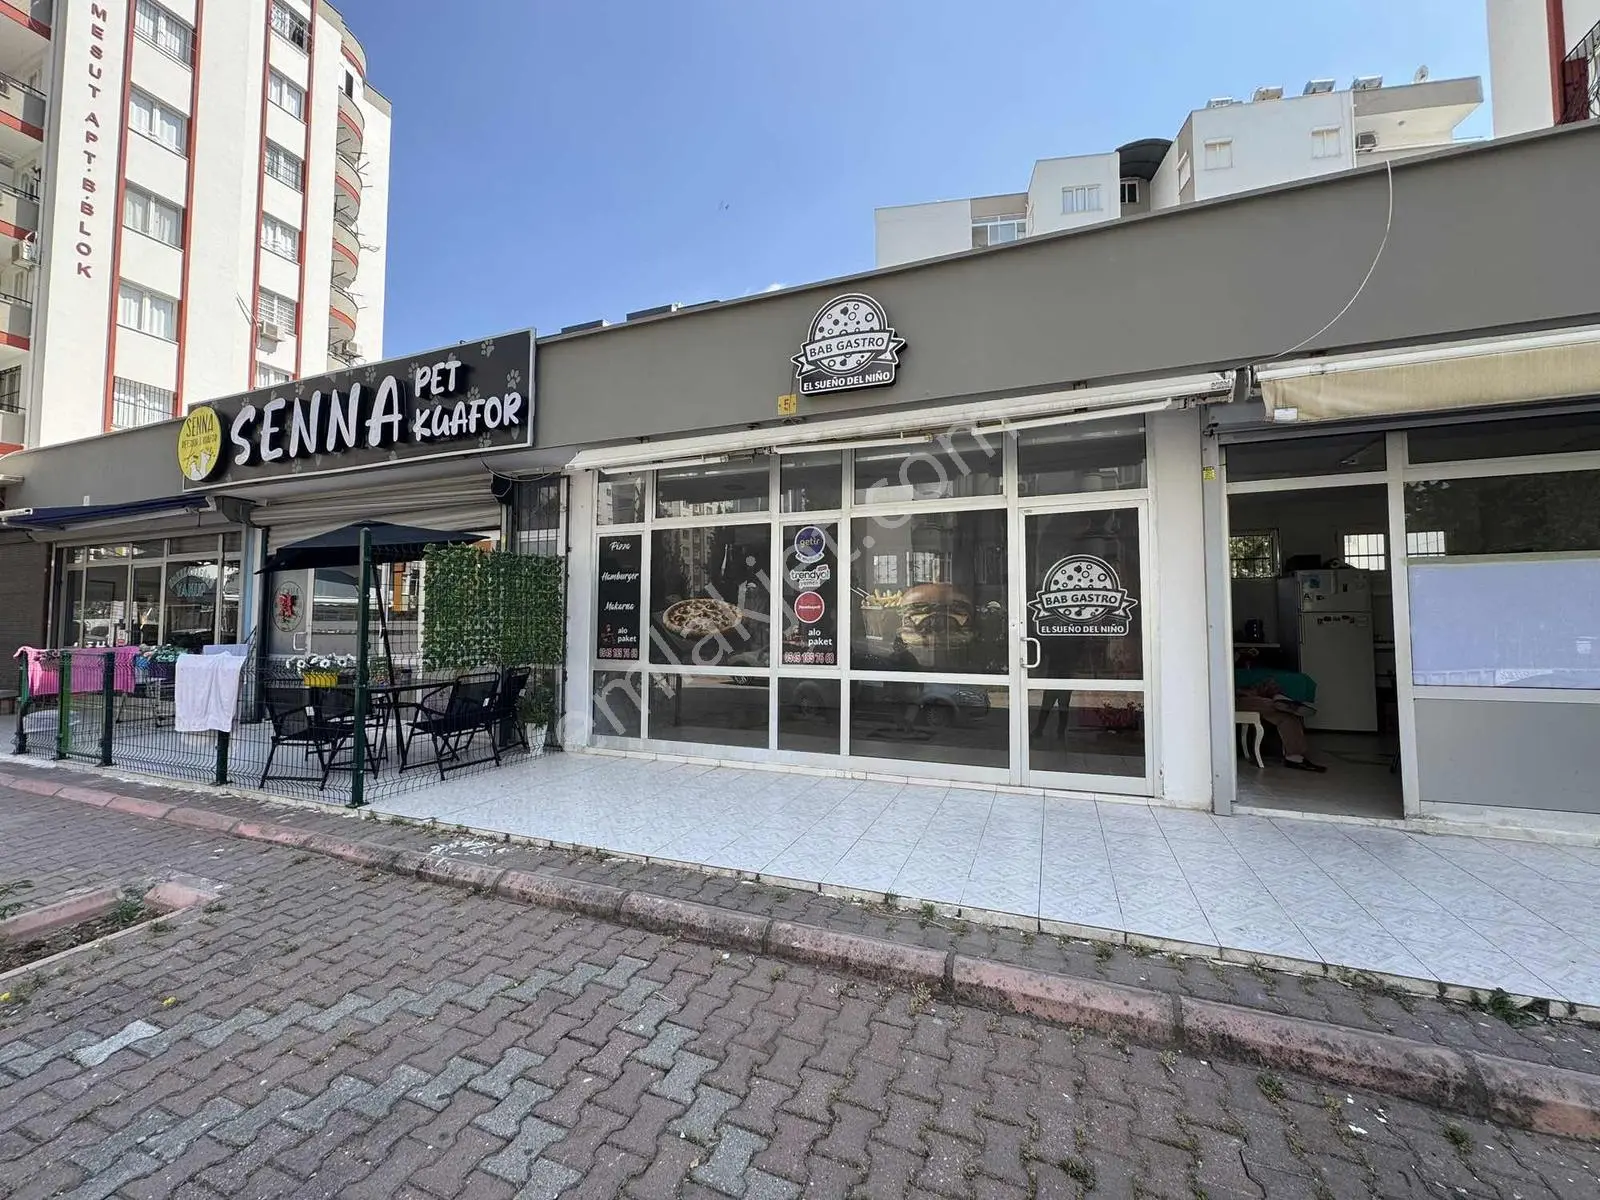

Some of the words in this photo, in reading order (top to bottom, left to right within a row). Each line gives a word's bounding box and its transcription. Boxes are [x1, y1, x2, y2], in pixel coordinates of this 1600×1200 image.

[88, 3, 108, 99] MESUT
[809, 344, 833, 358] BAB
[836, 337, 885, 351] GASTRO
[415, 360, 462, 398] PET
[803, 382, 814, 391] EL
[814, 376, 845, 389] SUEÑO
[847, 376, 864, 385] DEL
[865, 370, 890, 383] NIÑO
[231, 375, 403, 466] SENNA
[412, 392, 522, 442] KUAFOR
[186, 413, 214, 438] SENNA
[609, 541, 632, 551] Pizza
[601, 571, 639, 583] Hamburger
[1045, 595, 1068, 606] BAB
[1071, 593, 1118, 605] GASTRO
[604, 601, 635, 611] Makarna
[617, 626, 628, 634] alo
[808, 628, 821, 636] alo
[1041, 625, 1050, 633] EL
[1052, 623, 1082, 633] SUEÑO
[1083, 625, 1100, 633] DEL
[1101, 623, 1125, 633] NIÑO
[617, 633, 637, 644] paket
[808, 637, 833, 647] paket
